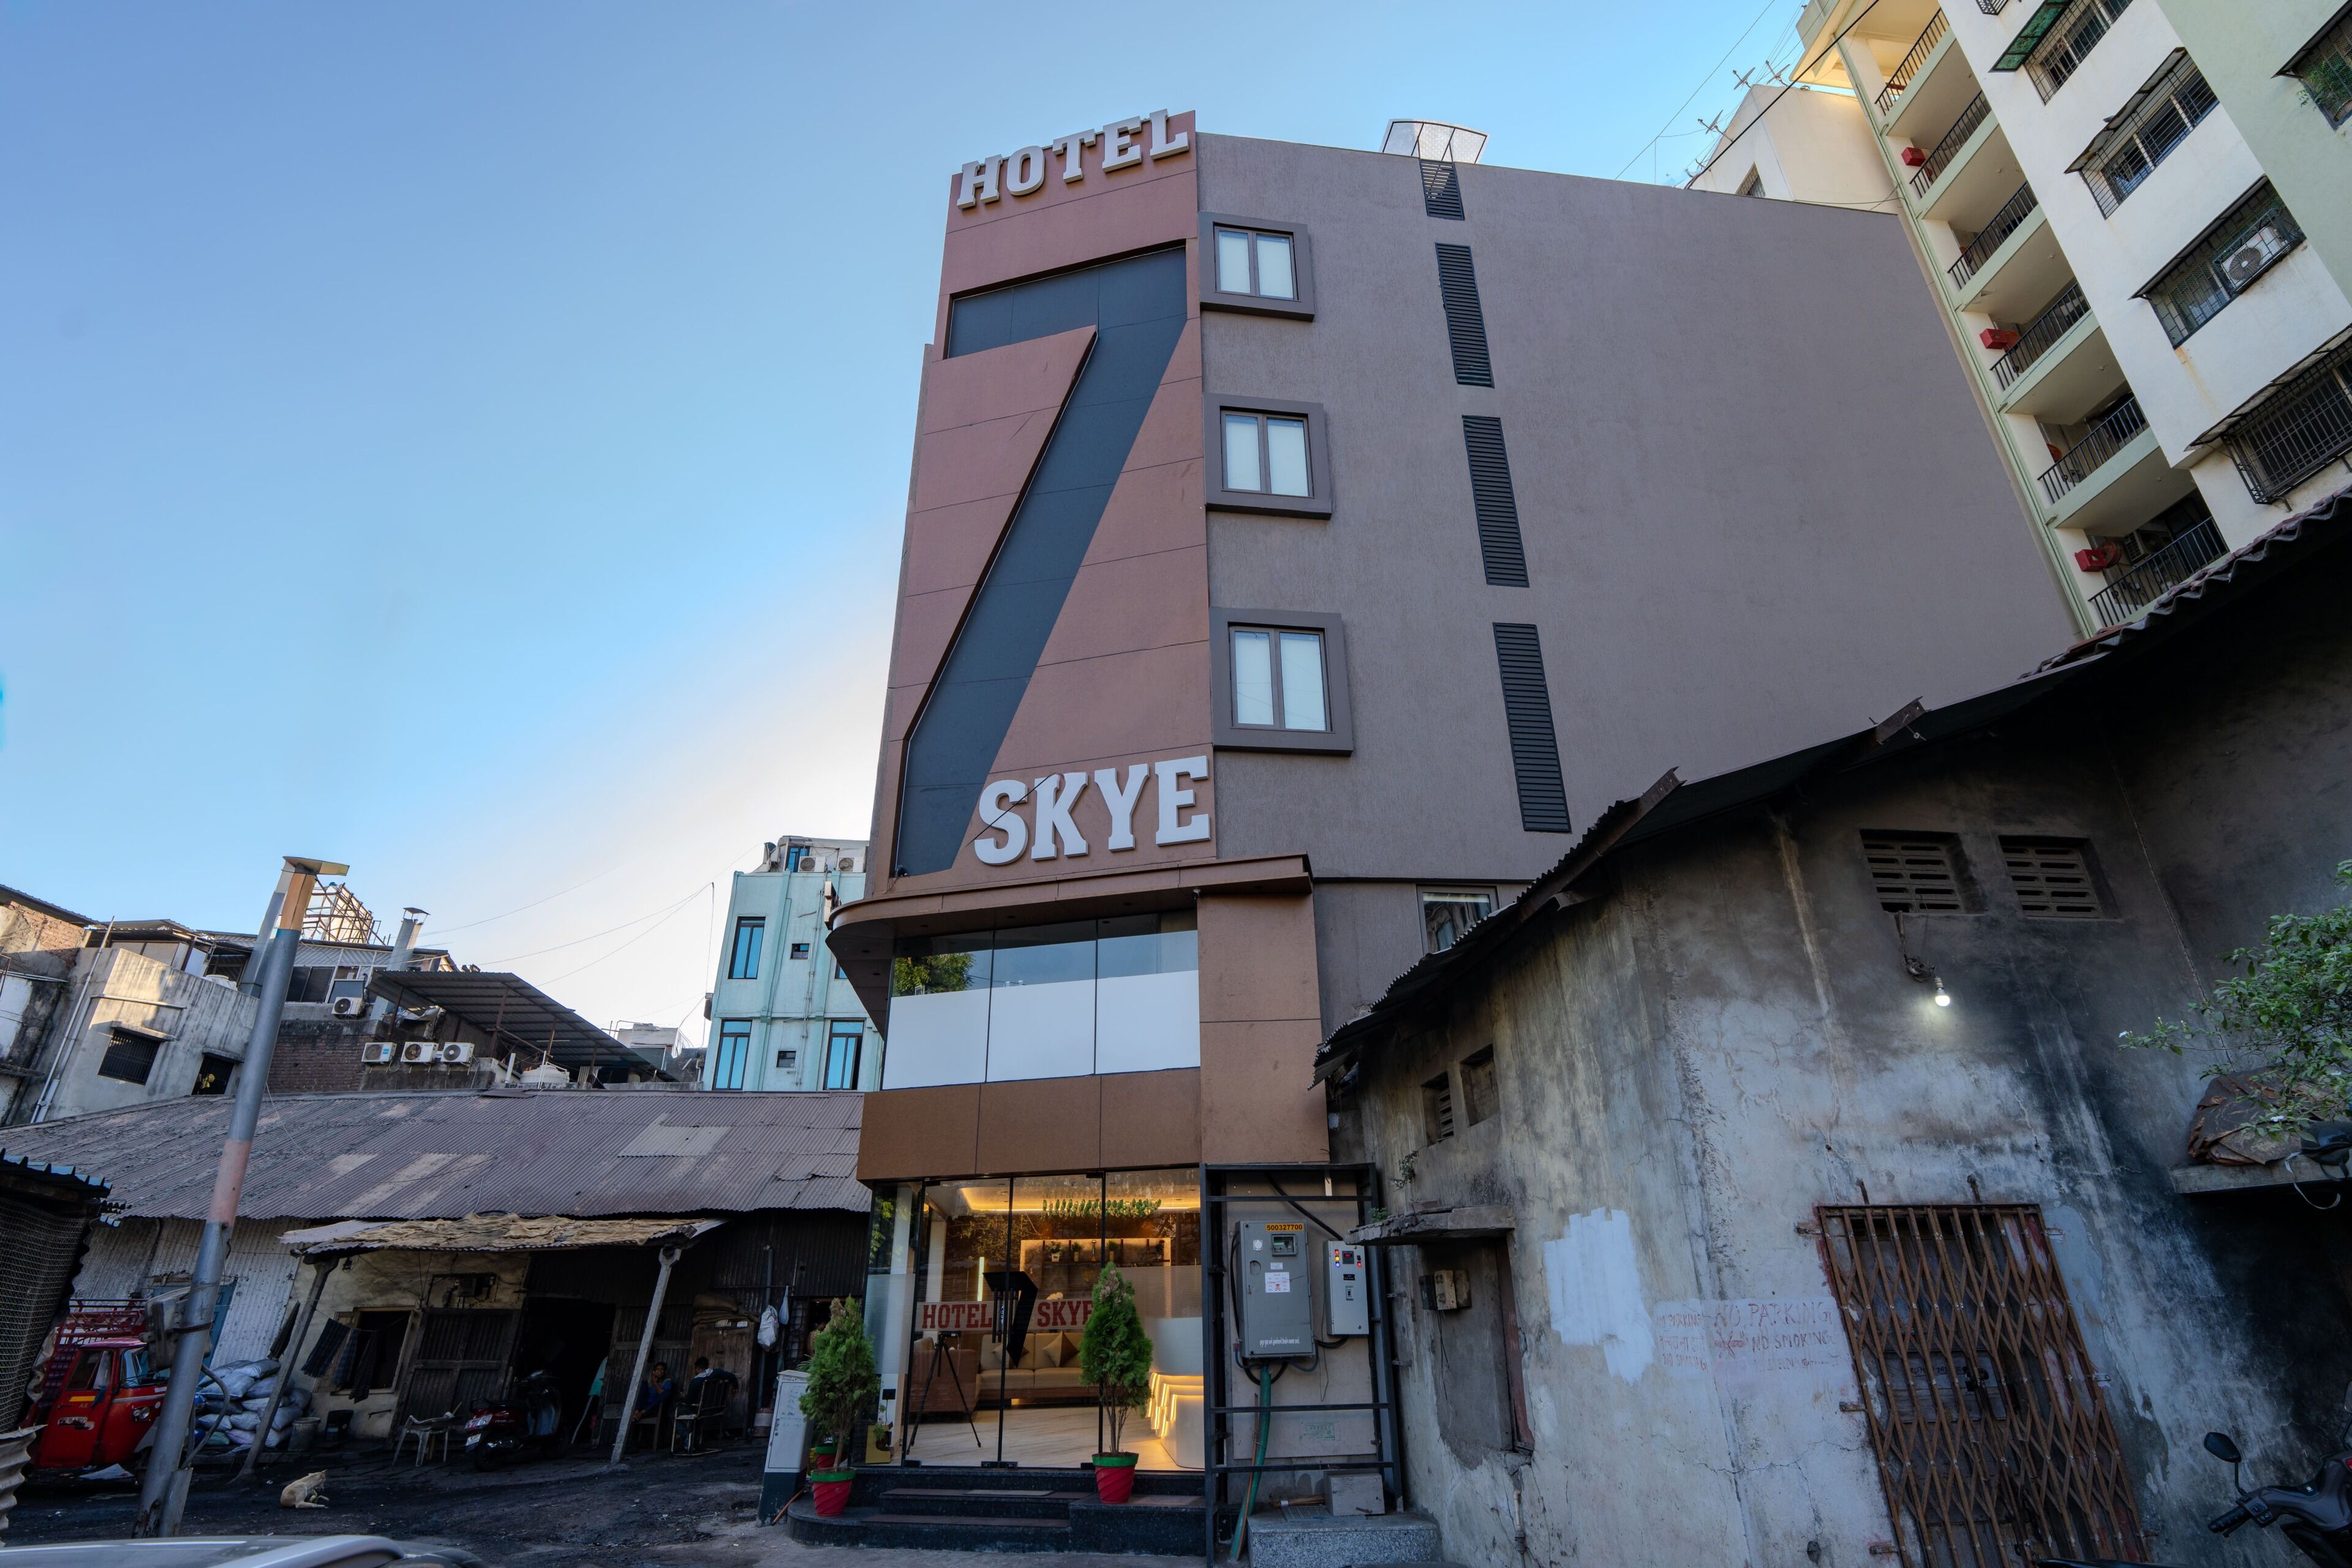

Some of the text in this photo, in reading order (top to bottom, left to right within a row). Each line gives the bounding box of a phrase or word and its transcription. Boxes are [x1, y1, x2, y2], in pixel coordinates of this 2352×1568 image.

[957, 108, 1189, 209] HOTEL
[974, 755, 1212, 866] SKYE
[922, 1303, 992, 1329] HOTEL
[1713, 1301, 1833, 1327] NO PARKING
[1752, 1329, 1835, 1352] NO SMOKING
[1662, 1352, 1673, 1367] NO
